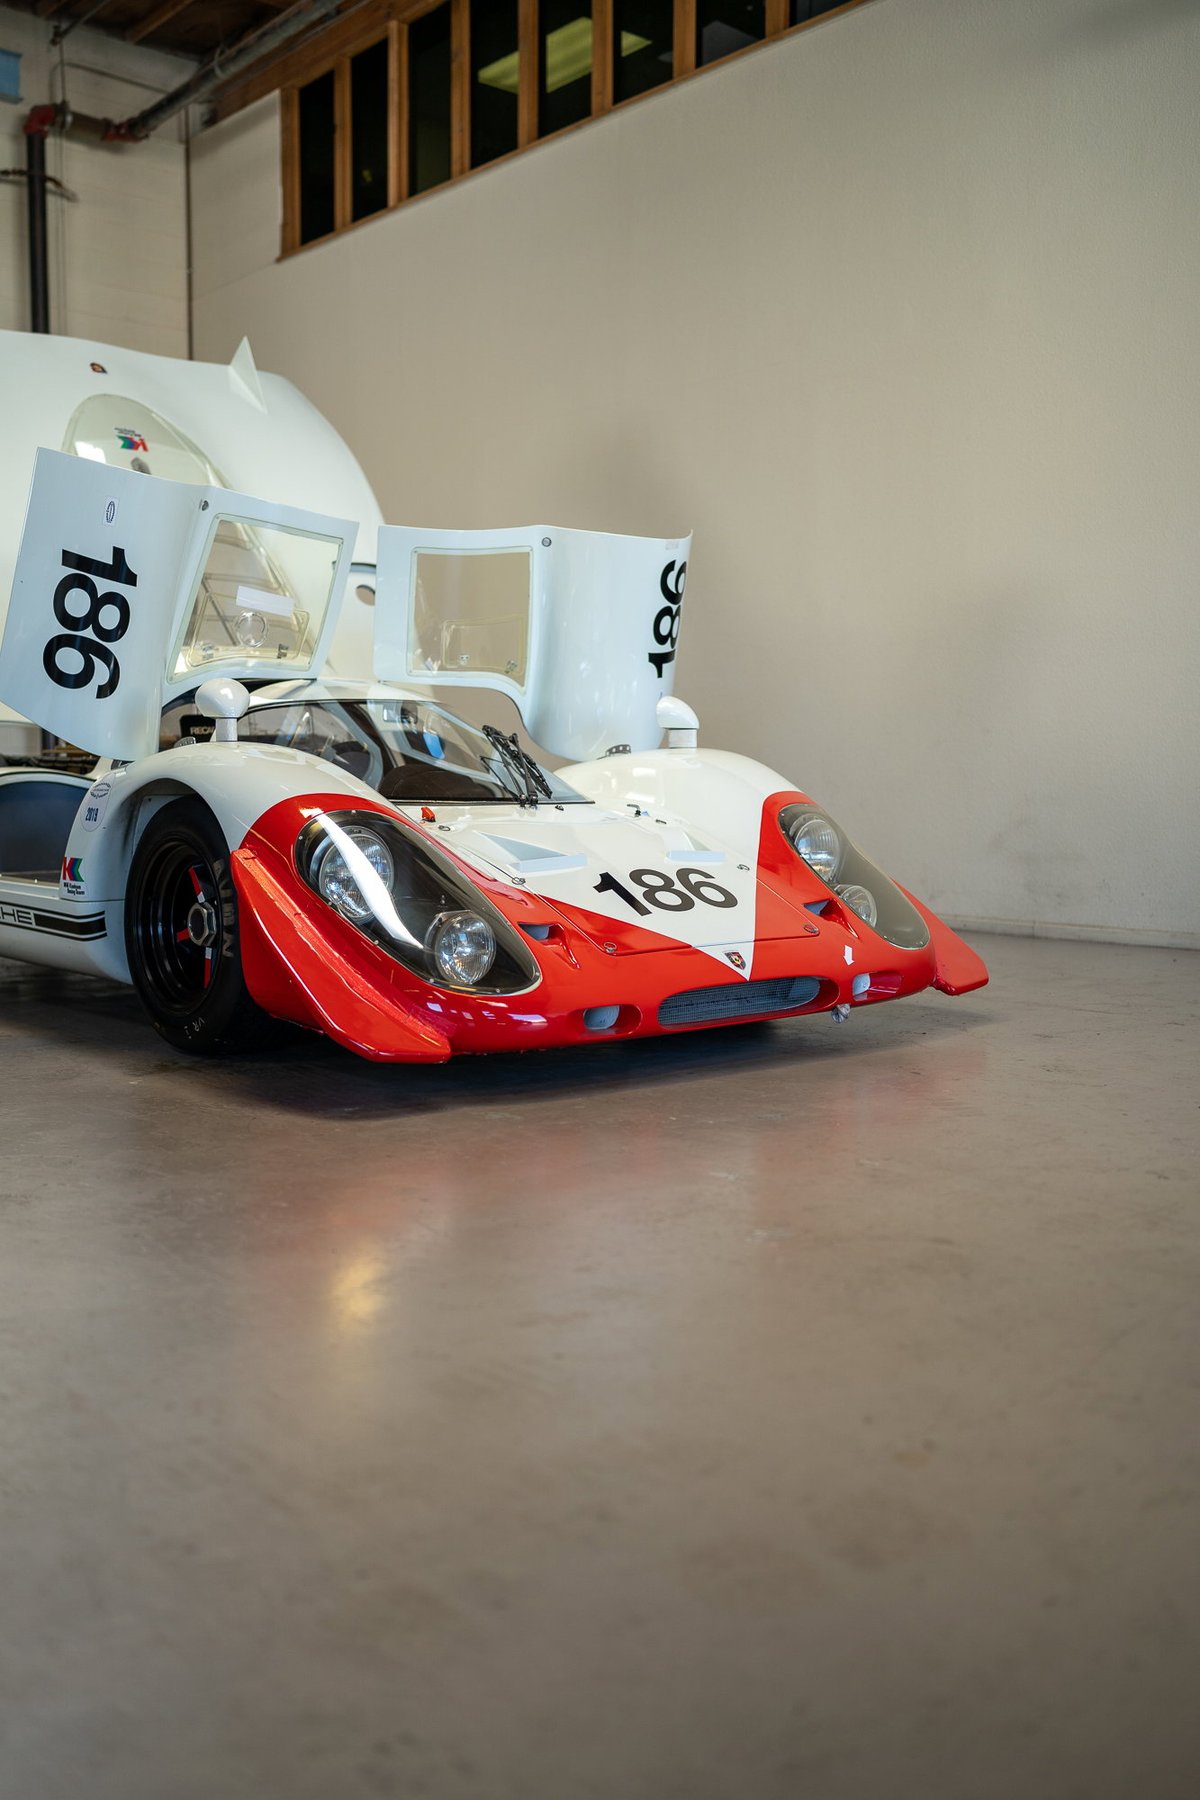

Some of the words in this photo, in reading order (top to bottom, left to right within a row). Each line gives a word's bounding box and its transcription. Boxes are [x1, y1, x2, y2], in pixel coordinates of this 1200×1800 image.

[43, 546, 138, 699] 186
[648, 559, 687, 678] 186
[190, 725, 216, 736] RECA
[0, 905, 33, 925] HE
[592, 867, 738, 917] 186
